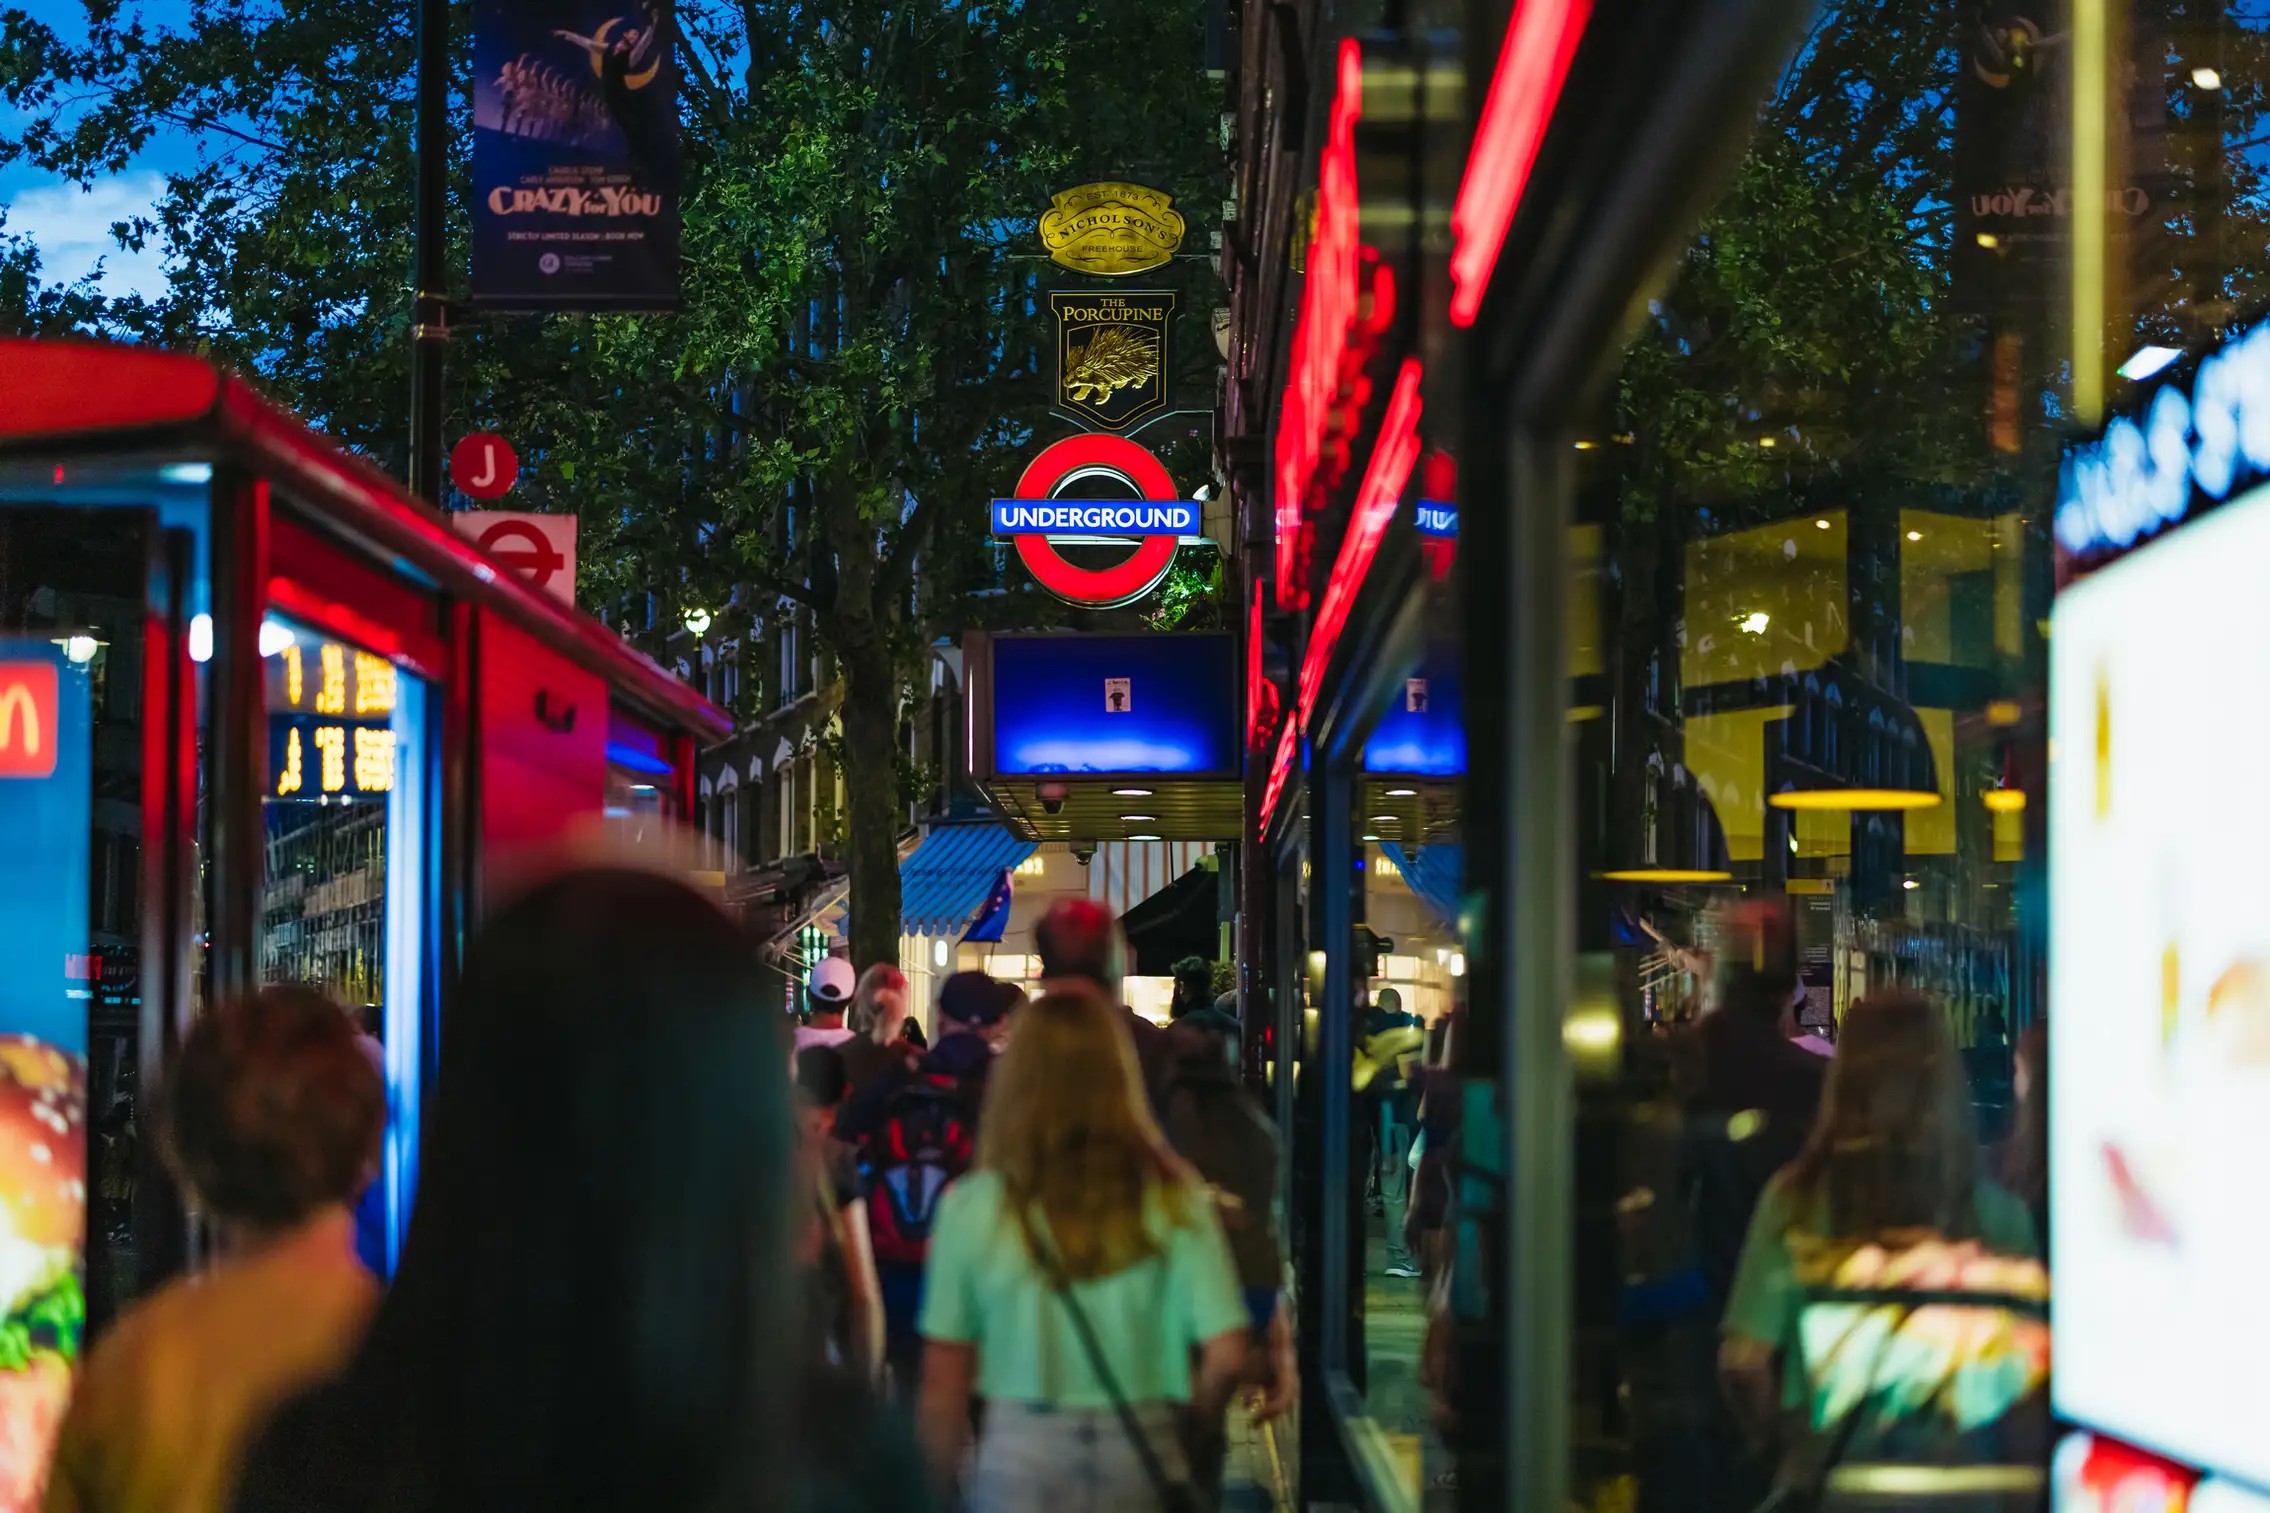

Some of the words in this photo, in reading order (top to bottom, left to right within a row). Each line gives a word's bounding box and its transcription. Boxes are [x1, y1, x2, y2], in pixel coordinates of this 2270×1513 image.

[488, 186, 591, 216] CRAZY
[584, 201, 607, 214] for
[600, 185, 662, 216] YOU
[1112, 190, 1139, 201] 1873
[1058, 214, 1167, 240] NICHOLSON'S
[507, 232, 540, 240] STRICTLY
[541, 232, 570, 240] LIMITED
[627, 232, 645, 240] NOW
[1082, 245, 1143, 253] FREEHOUSE
[1100, 298, 1126, 307] THE
[1063, 306, 1164, 321] PORCUPINE
[471, 444, 496, 487] J
[1001, 507, 1190, 528] UNDERGROUND
